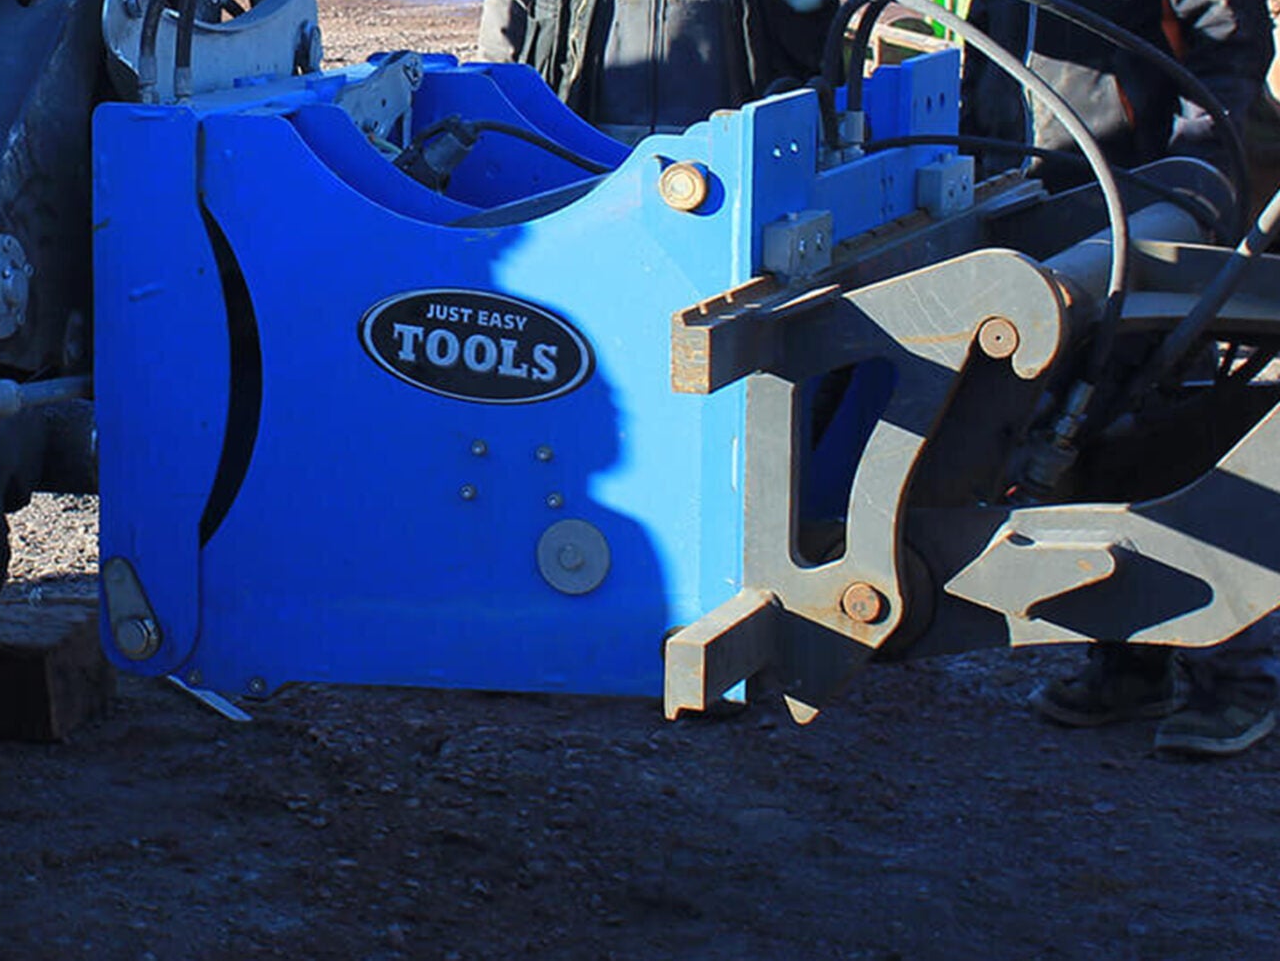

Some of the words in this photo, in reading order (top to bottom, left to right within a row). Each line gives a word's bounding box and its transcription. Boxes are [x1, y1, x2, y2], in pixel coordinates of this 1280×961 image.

[426, 303, 473, 323] JUST
[477, 310, 528, 331] EASY
[392, 322, 558, 382] TOOLS
